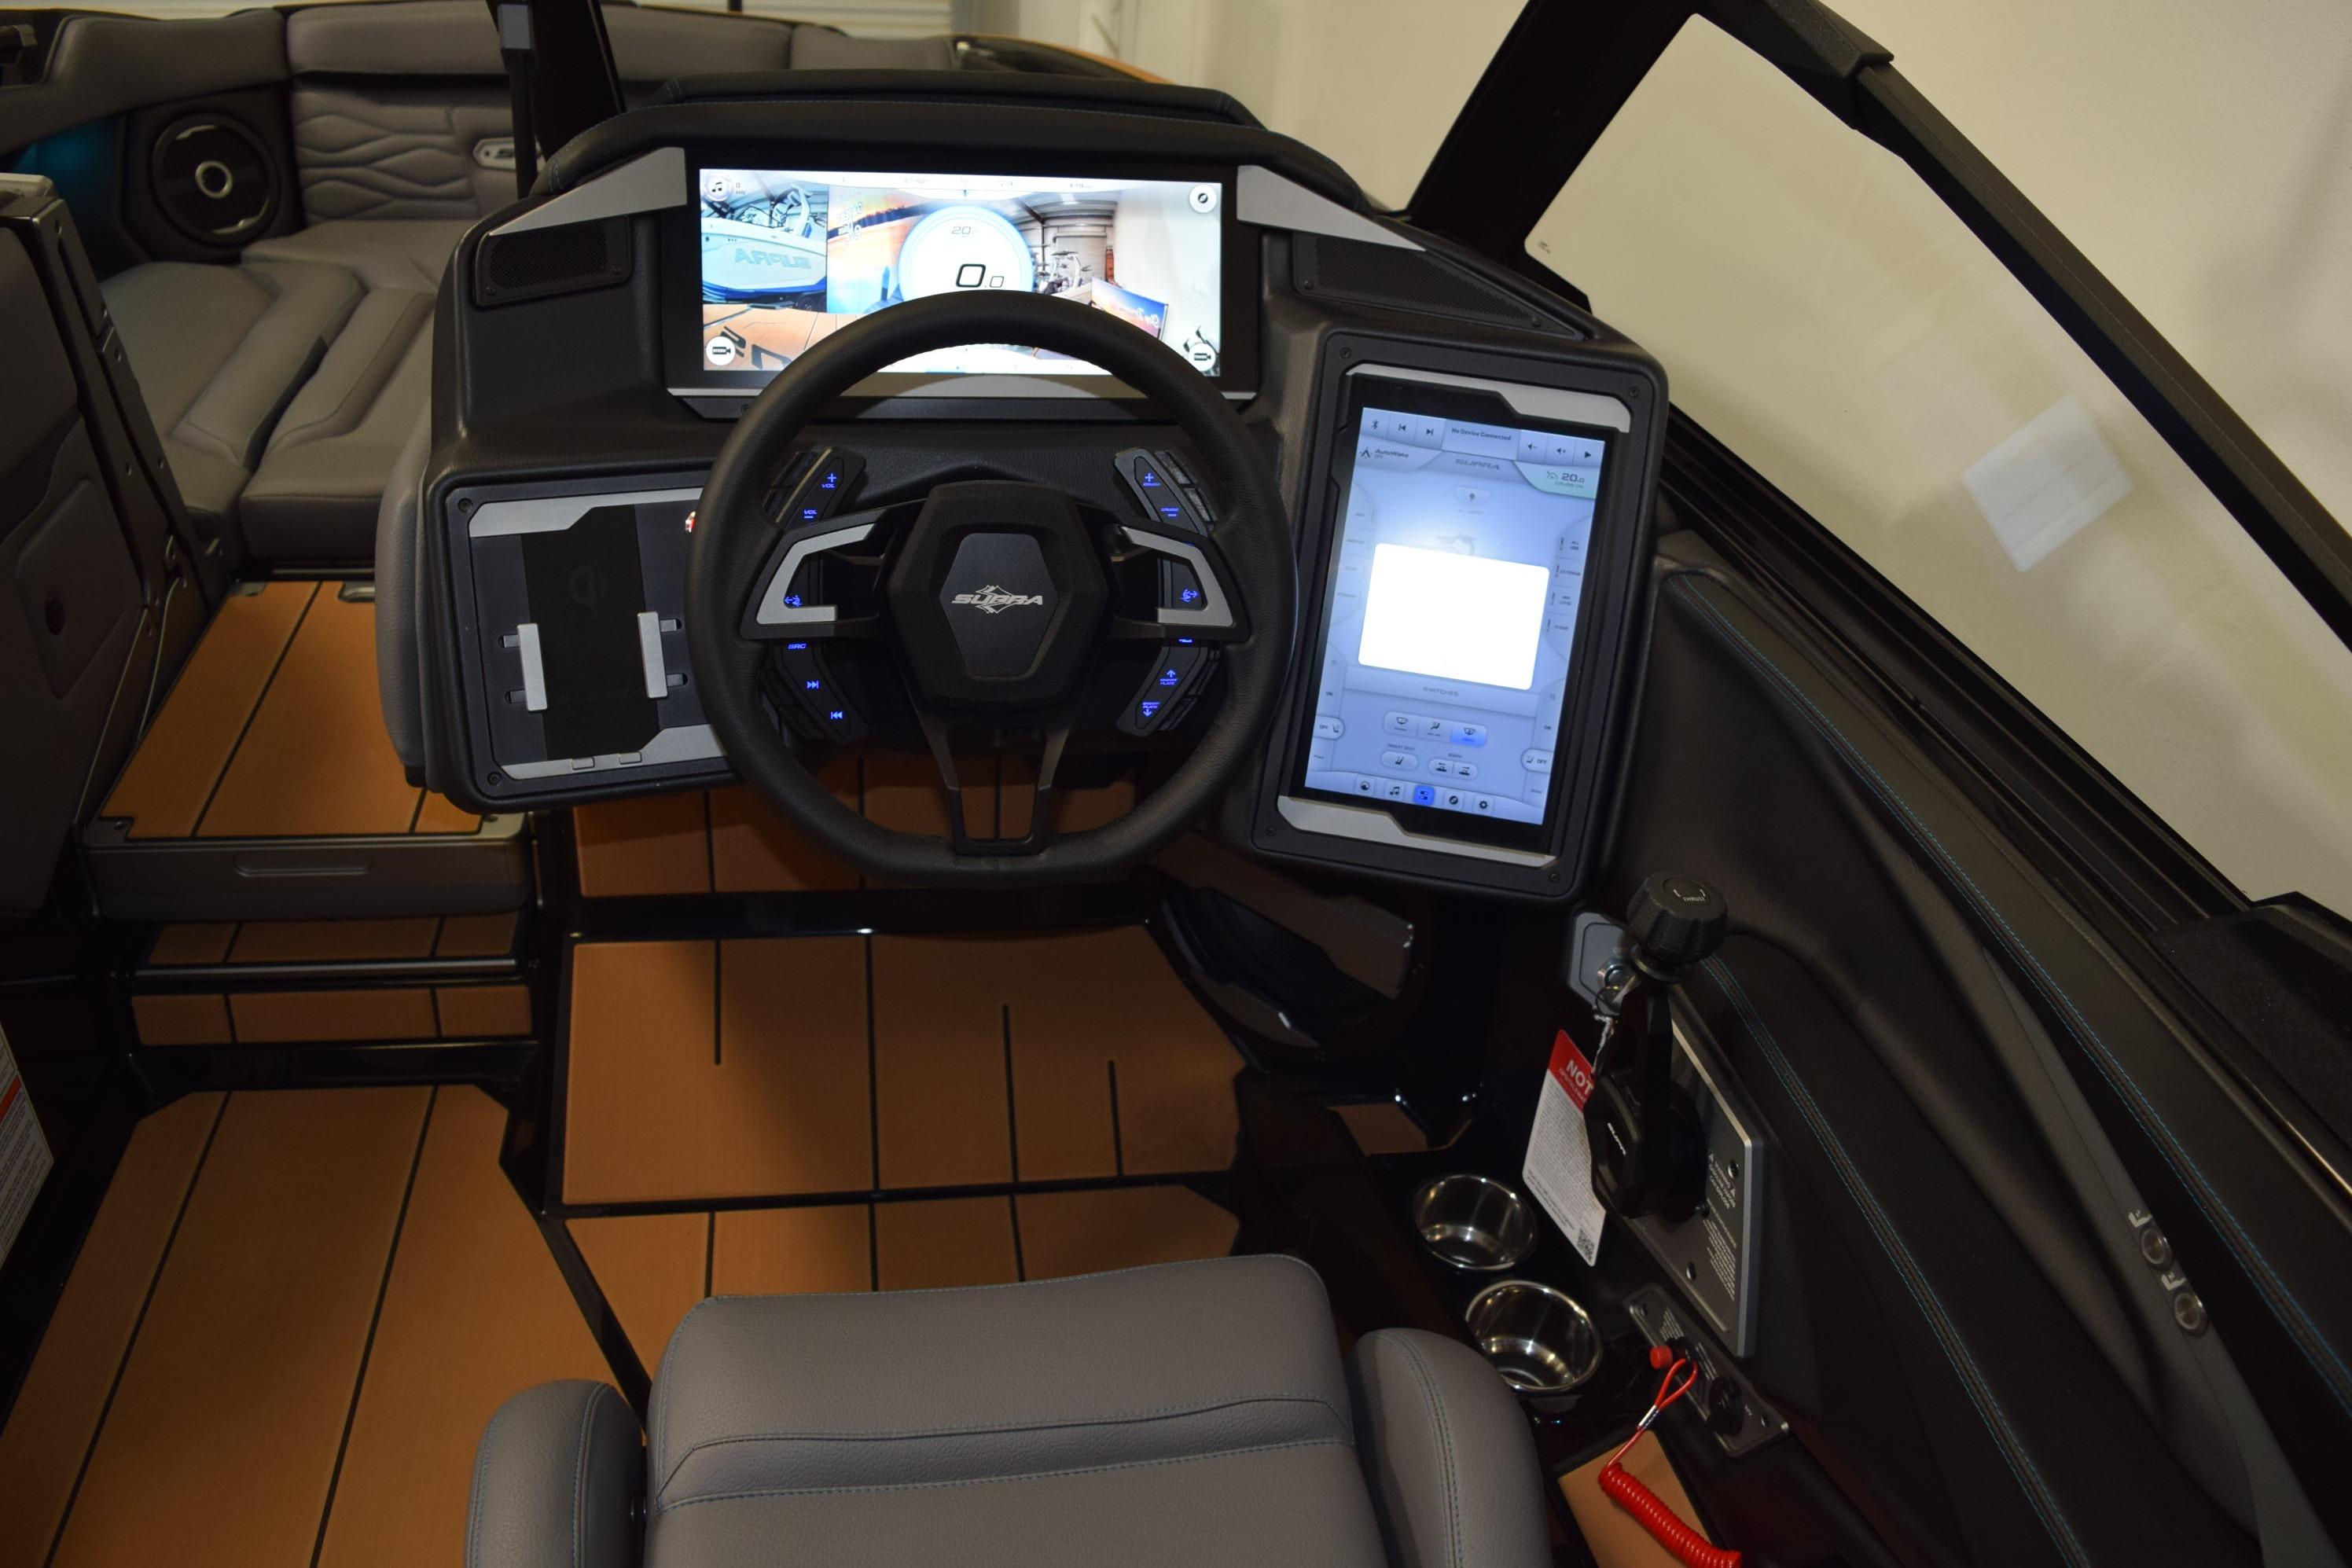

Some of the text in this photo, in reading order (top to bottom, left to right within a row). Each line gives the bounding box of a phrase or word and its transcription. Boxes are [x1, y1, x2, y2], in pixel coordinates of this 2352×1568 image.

[1480, 431, 1511, 441] Connected
[1374, 448, 1409, 458] AutoWake
[1454, 458, 1501, 470] SUPRA
[950, 593, 1044, 606] SUPRA
[1422, 686, 1460, 697] SWITCHES
[1566, 1059, 1594, 1096] NOT
